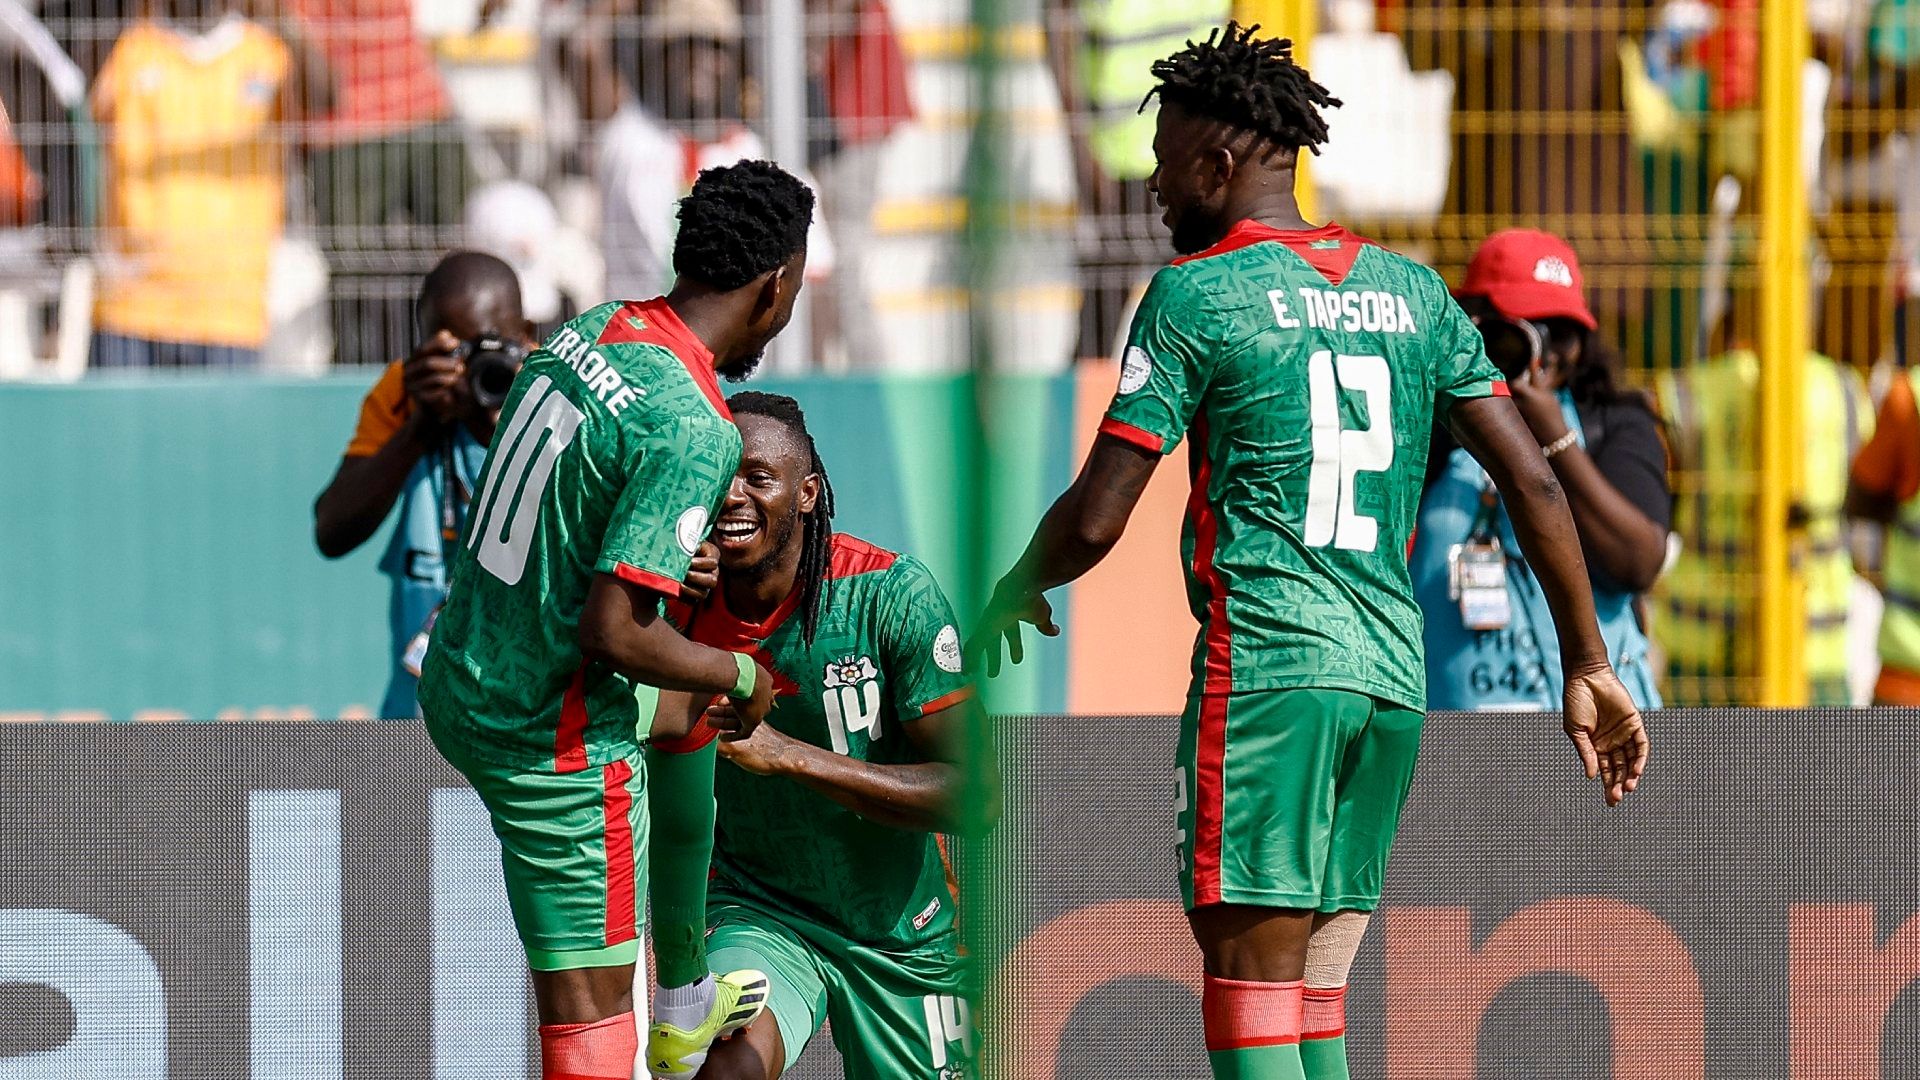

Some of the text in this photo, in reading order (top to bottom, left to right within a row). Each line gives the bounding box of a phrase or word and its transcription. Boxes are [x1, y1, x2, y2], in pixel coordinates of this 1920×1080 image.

[1267, 287, 1417, 334] E. TAPSOBA
[547, 328, 647, 417] TRAORÉ
[467, 375, 586, 586] 10
[1303, 350, 1394, 553] 12
[823, 680, 882, 755] 14
[924, 993, 972, 1069] 14
